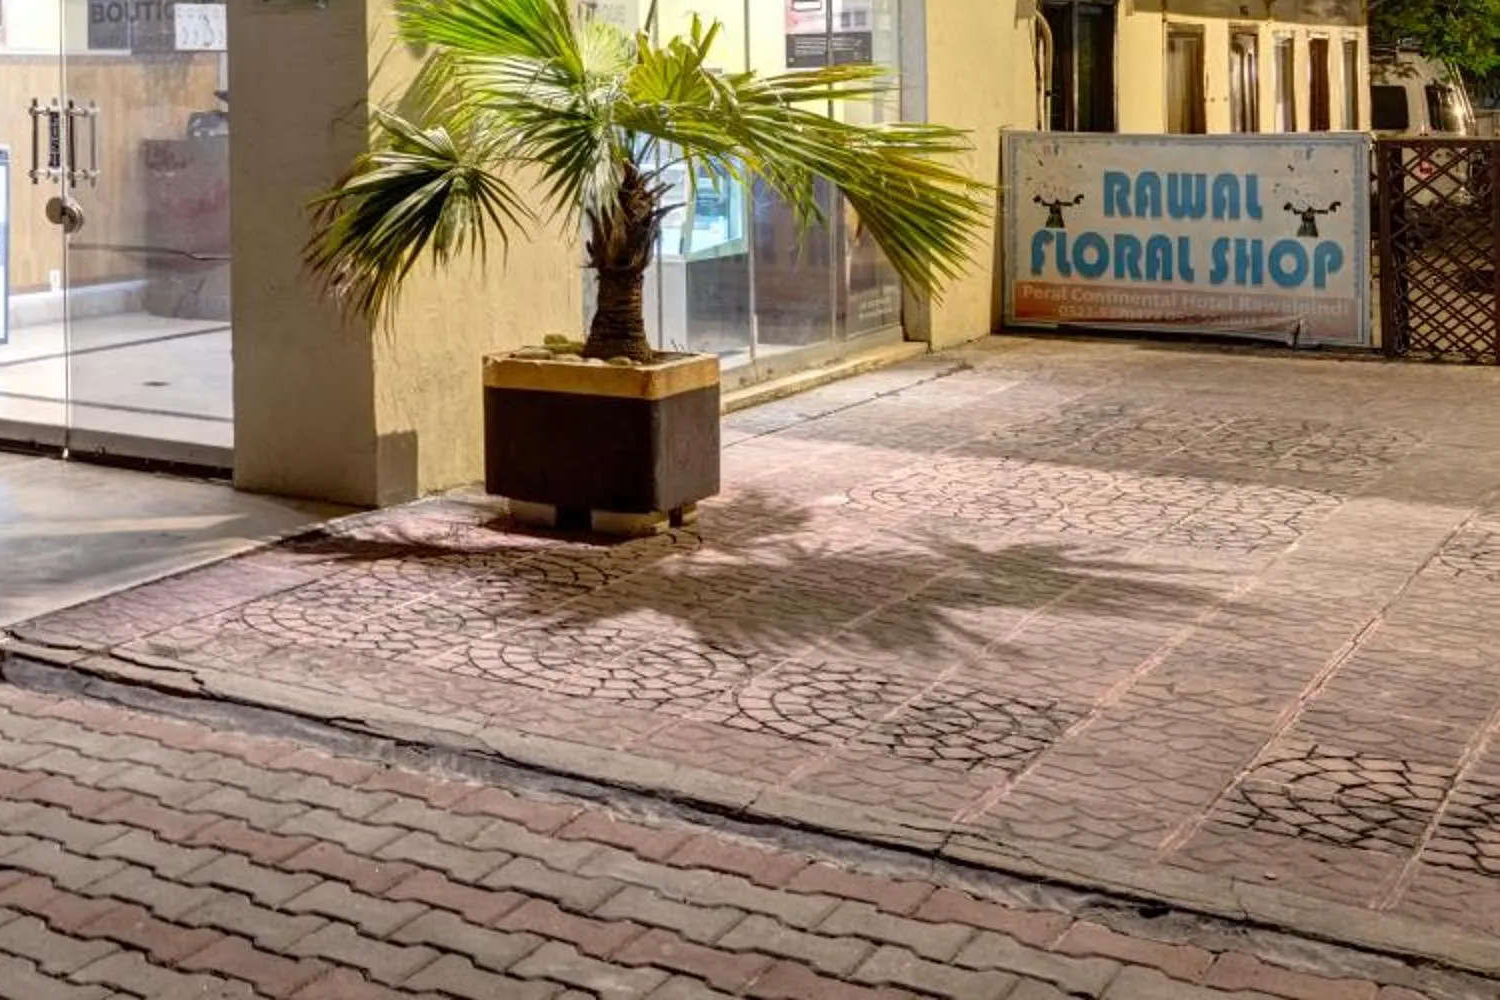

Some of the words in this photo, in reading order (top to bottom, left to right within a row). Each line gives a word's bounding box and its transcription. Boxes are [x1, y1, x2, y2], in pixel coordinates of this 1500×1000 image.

[1103, 171, 1264, 221] RAWAL
[1030, 228, 1196, 283] FLORAL
[1208, 236, 1345, 290] SHOP
